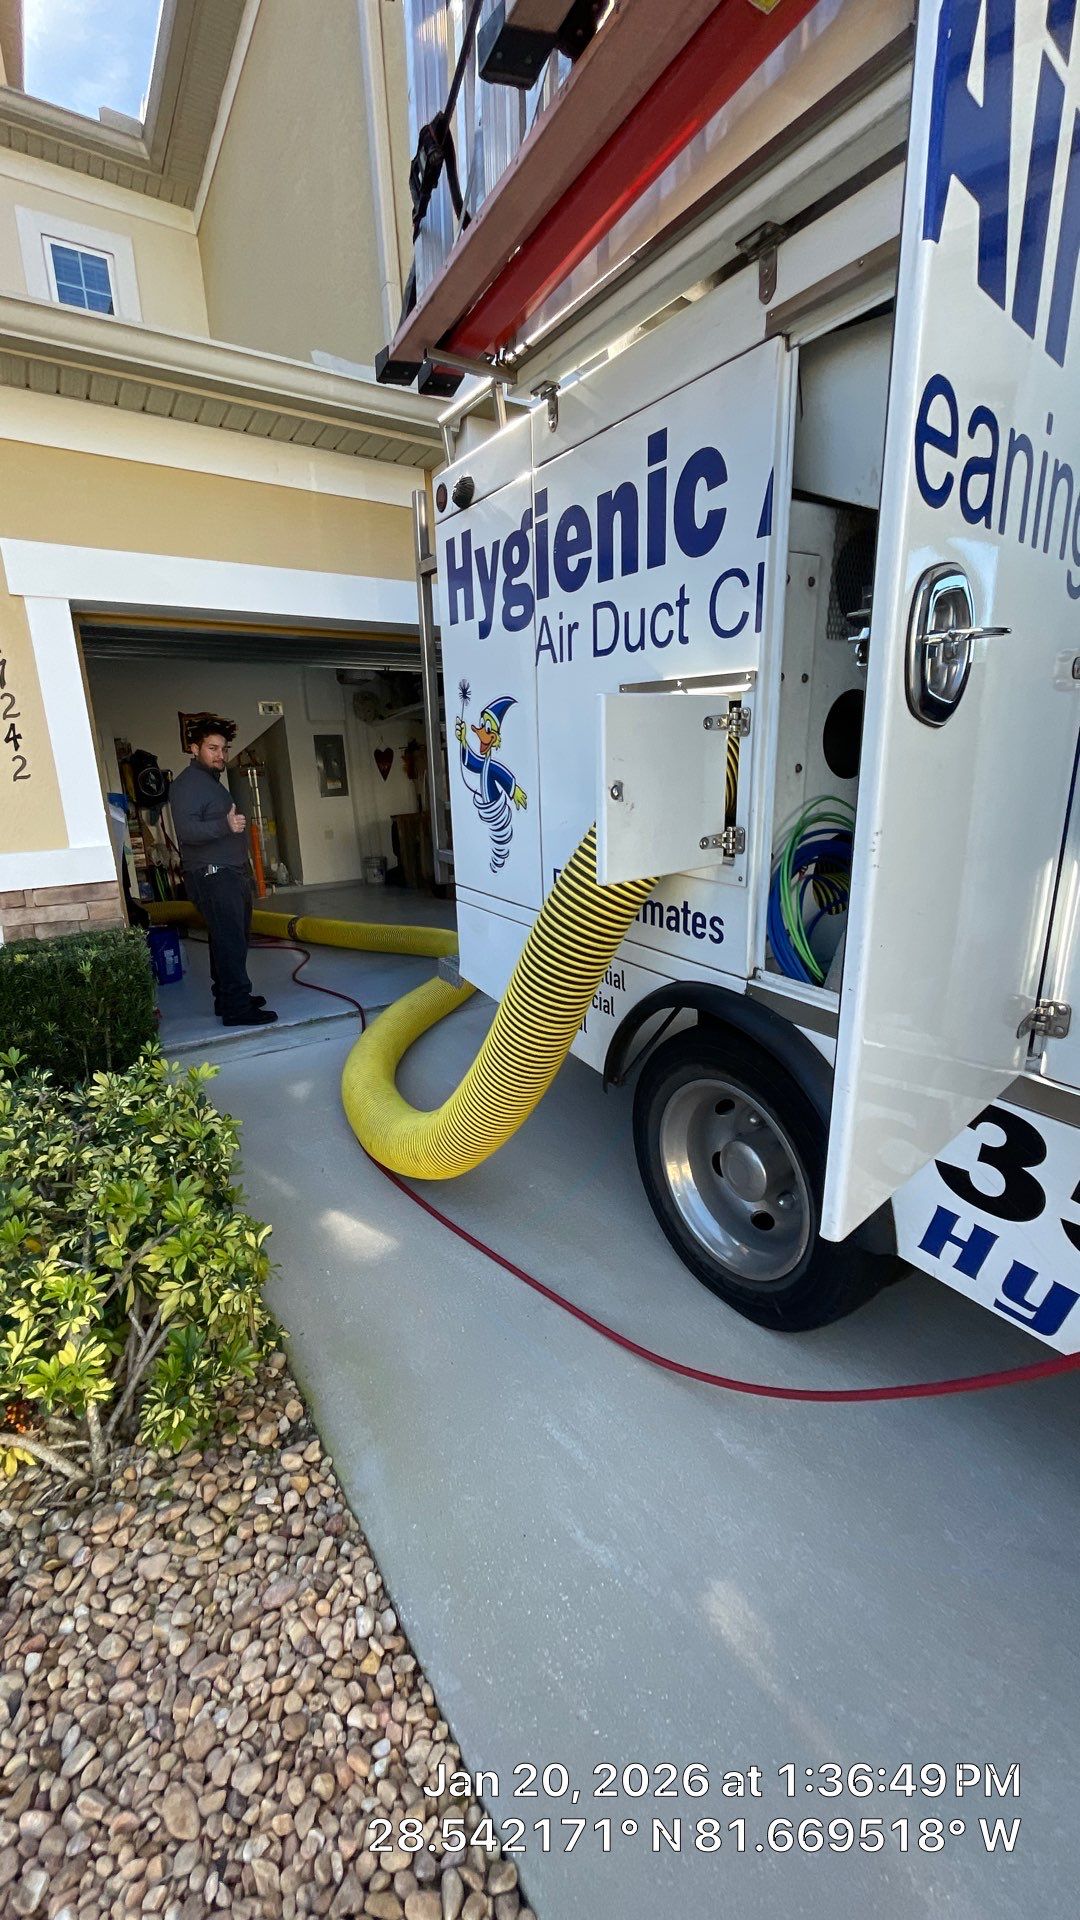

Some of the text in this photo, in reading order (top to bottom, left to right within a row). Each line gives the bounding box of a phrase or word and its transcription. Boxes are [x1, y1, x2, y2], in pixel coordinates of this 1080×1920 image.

[445, 427, 728, 640] Hygienic
[535, 562, 766, 667] Air Duct Cl
[601, 965, 626, 992] tial
[636, 900, 725, 944] mates
[935, 1104, 1080, 1252] 3
[917, 1204, 1080, 1336] Hy
